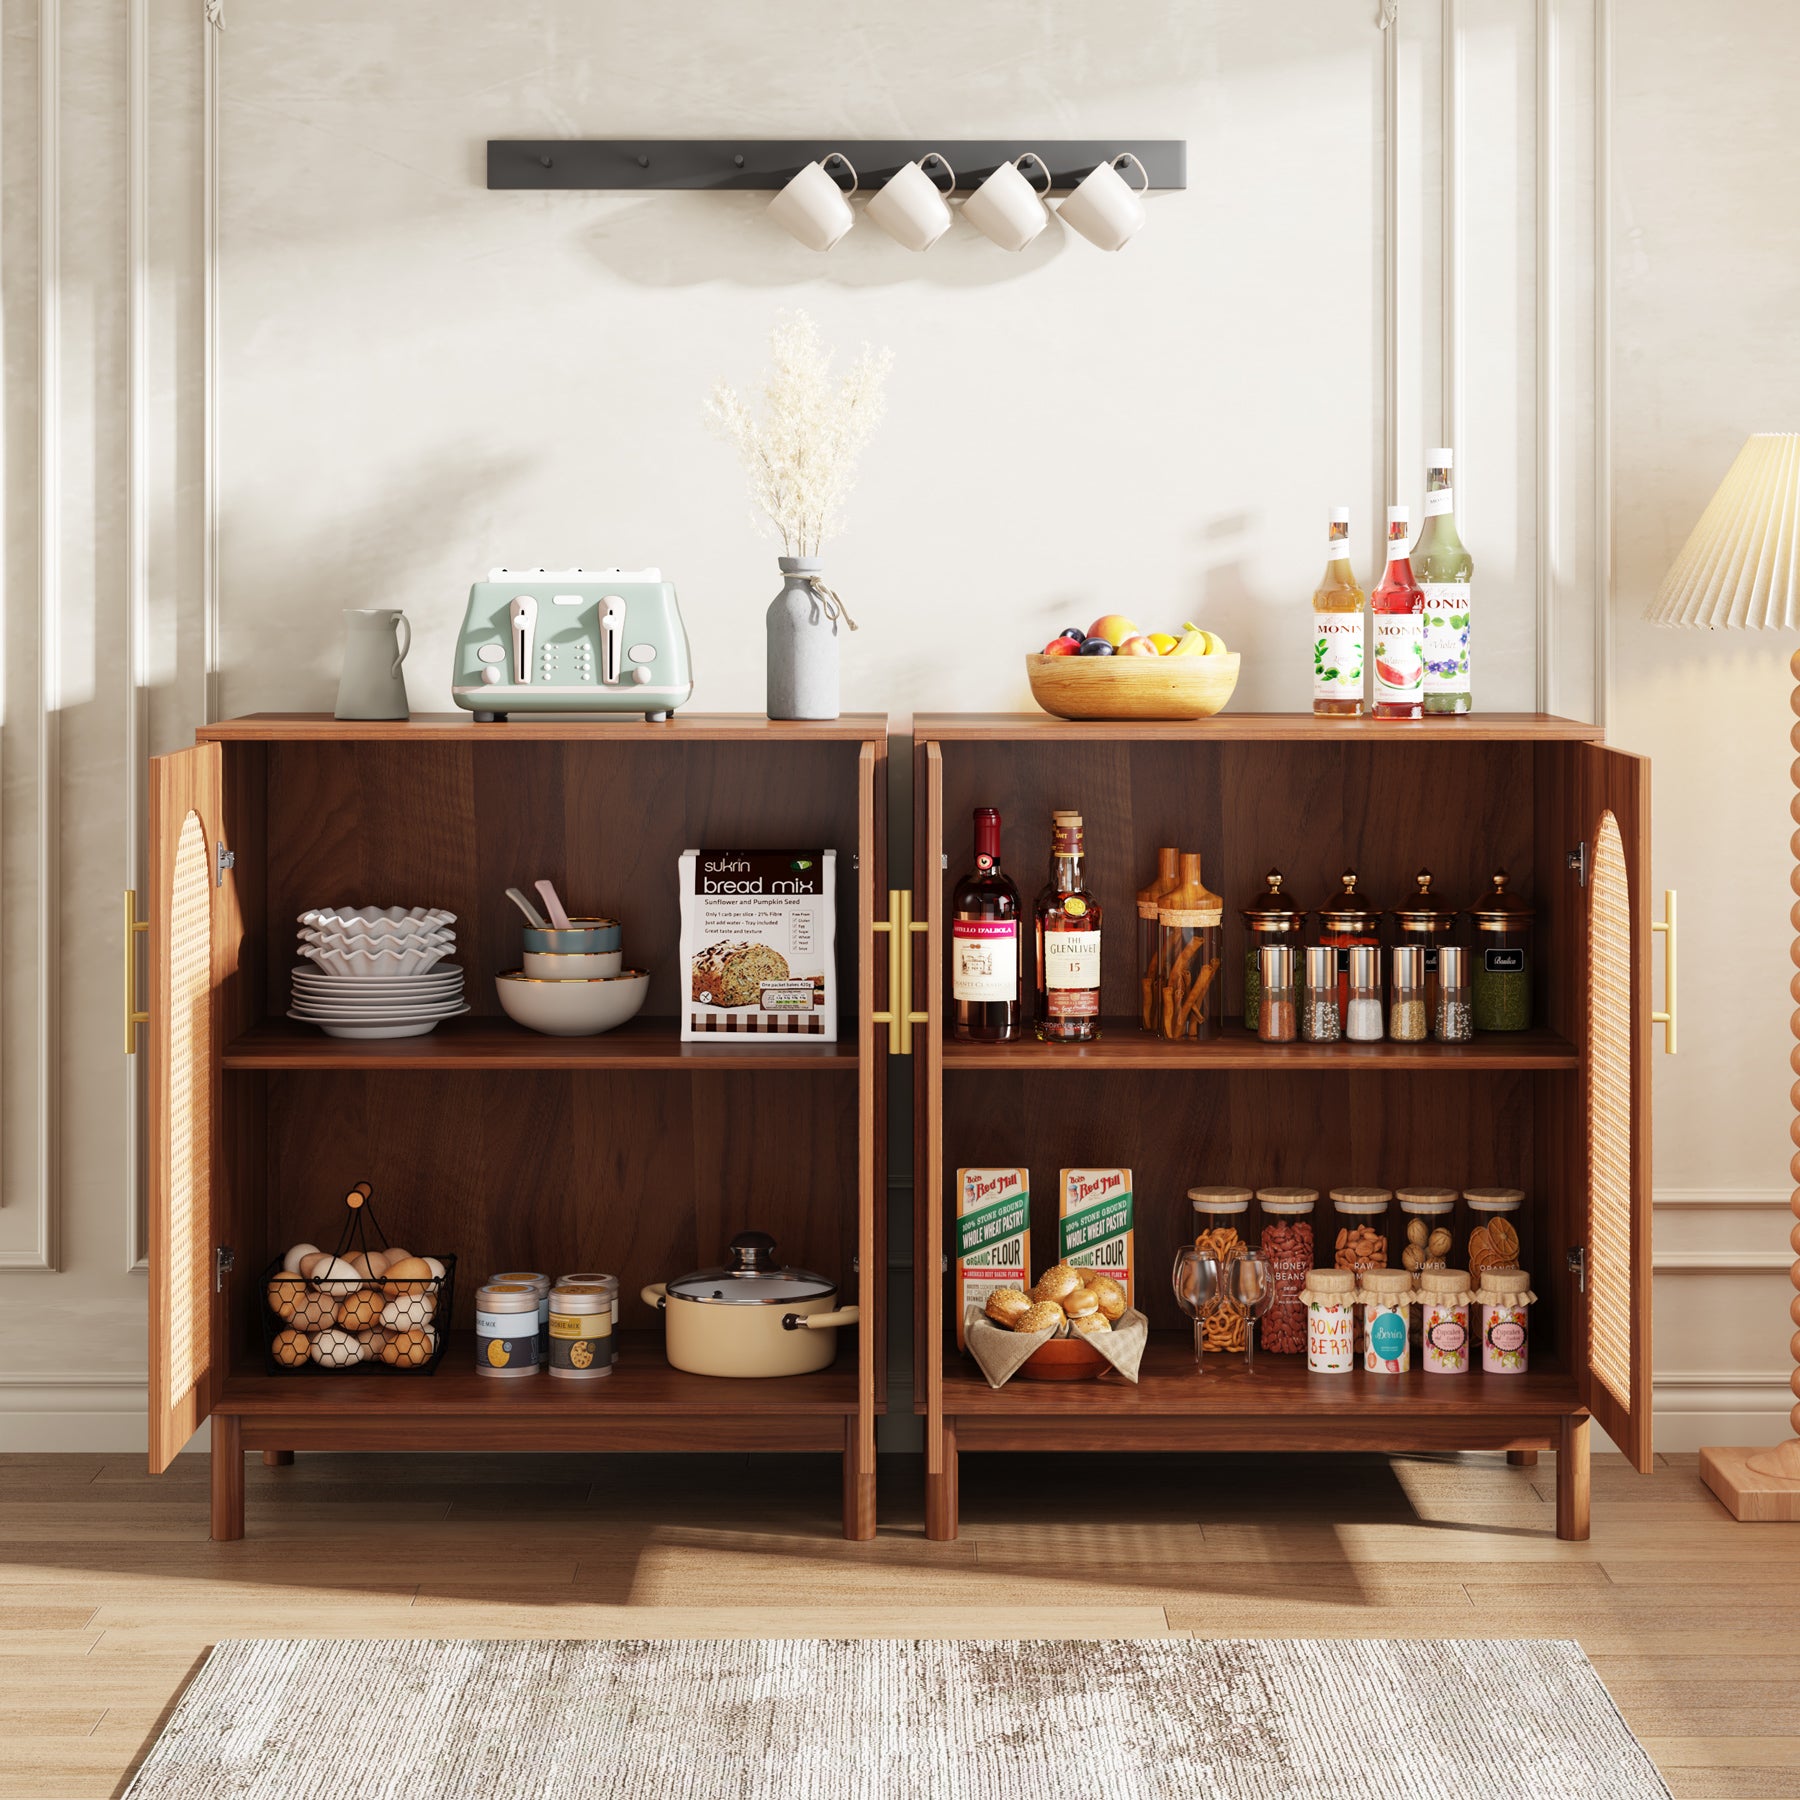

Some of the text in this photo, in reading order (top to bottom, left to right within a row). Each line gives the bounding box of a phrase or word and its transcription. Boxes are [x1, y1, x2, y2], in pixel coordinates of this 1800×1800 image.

[1424, 600, 1468, 608] ONIN
[704, 858, 750, 872] sukrin
[704, 876, 813, 893] bread mix
[1050, 943, 1096, 954] GLENLIVET
[1070, 962, 1080, 972] 15
[976, 1178, 996, 1202] Red
[997, 1173, 1017, 1194] Mill
[1079, 1179, 1099, 1202] Red
[1100, 1174, 1120, 1195] Mill
[977, 1210, 997, 1226] STONE
[998, 1199, 1024, 1216] GROUND
[1080, 1210, 1101, 1226] STONE
[1101, 1200, 1127, 1217] GROUND
[962, 1209, 1024, 1250] WHOLE WHEAT PASTRY
[1066, 1209, 1127, 1250] WHOLE WHEAT PASTRY
[966, 1239, 1021, 1266] ORGANIC FLOUR
[1069, 1239, 1124, 1266] ORGANIC FLOUR
[1273, 1261, 1306, 1270] KIDNEY
[1354, 1262, 1374, 1270] RAW
[1415, 1262, 1446, 1270] JUMBO
[1275, 1272, 1305, 1280] BEANS
